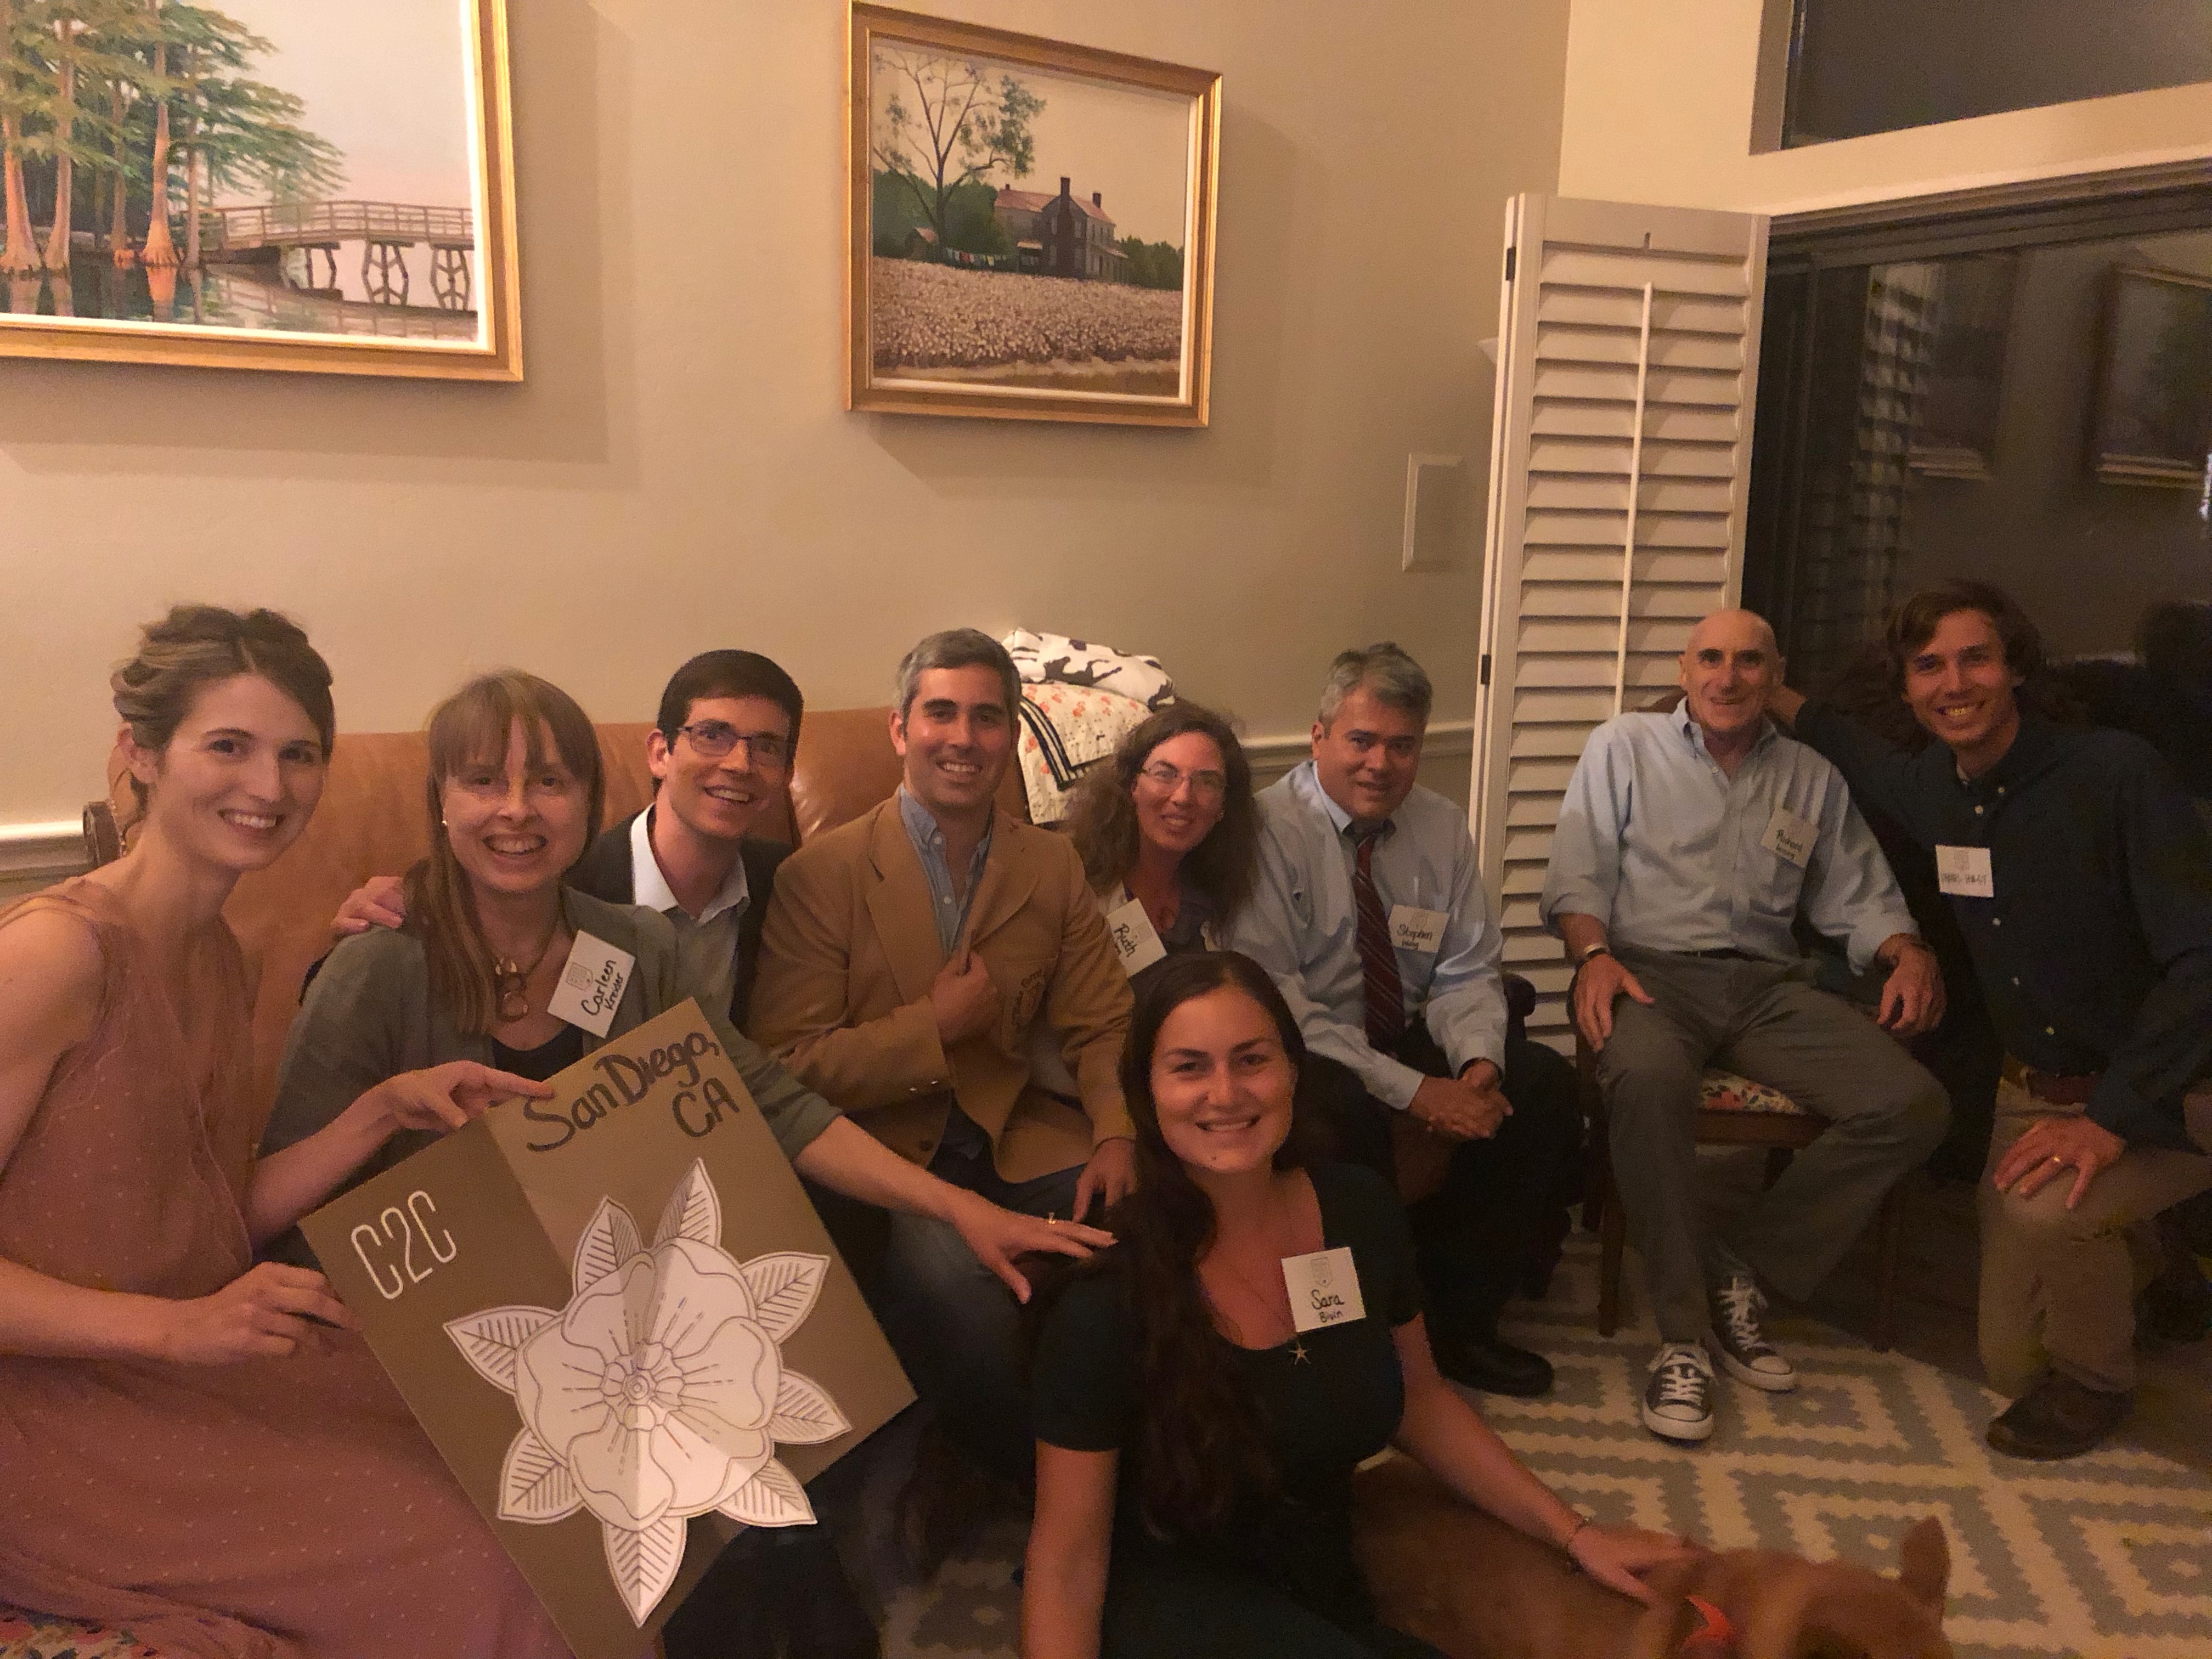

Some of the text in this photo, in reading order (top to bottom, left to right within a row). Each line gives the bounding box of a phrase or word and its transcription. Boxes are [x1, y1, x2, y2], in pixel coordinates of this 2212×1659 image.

[1114, 923, 1138, 957] Ruth
[1397, 924, 1432, 941] Stephen
[581, 960, 617, 1016] Carleen
[523, 1083, 618, 1152] San
[673, 1077, 740, 1137] CA
[351, 1190, 456, 1299] C2C
[1311, 1289, 1345, 1310] Sara
